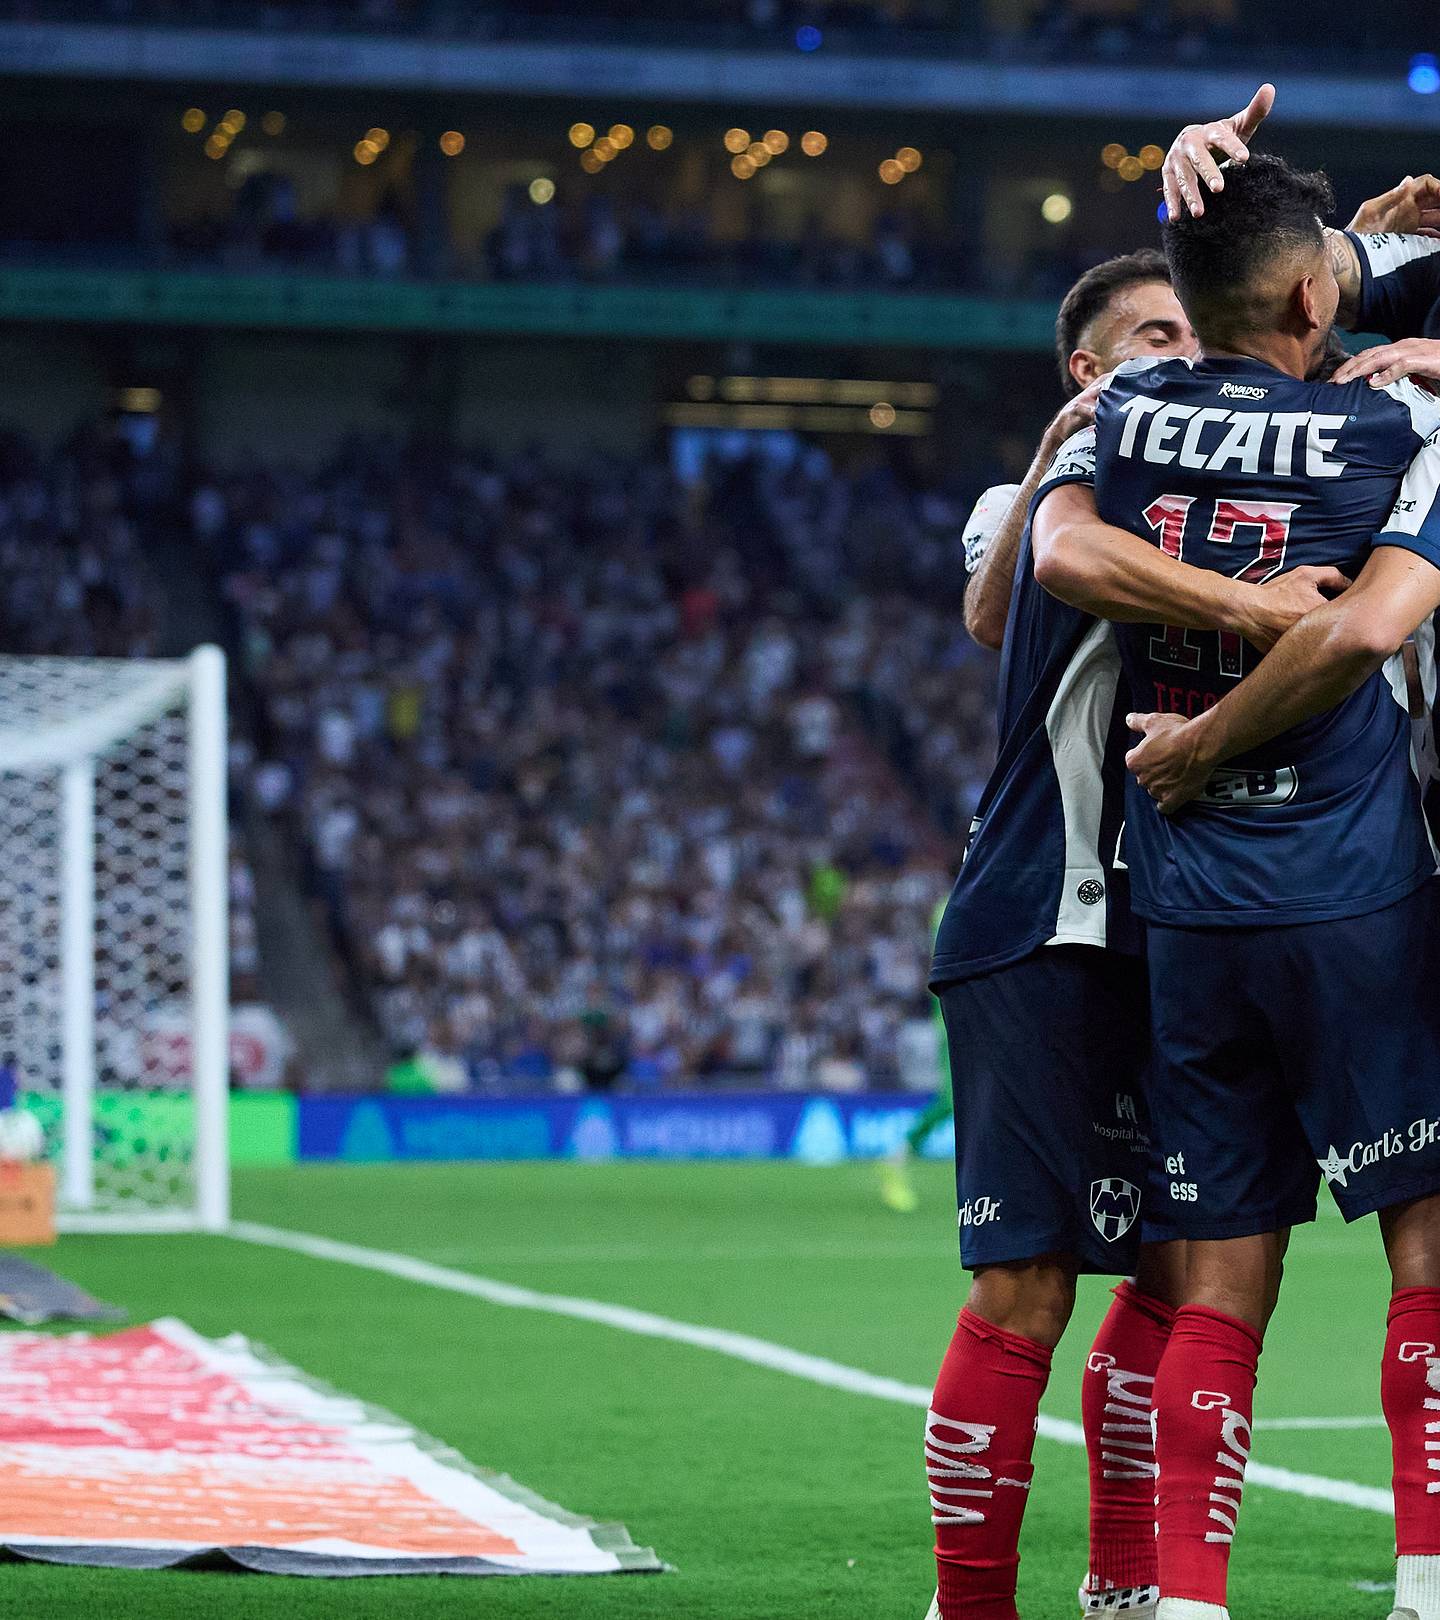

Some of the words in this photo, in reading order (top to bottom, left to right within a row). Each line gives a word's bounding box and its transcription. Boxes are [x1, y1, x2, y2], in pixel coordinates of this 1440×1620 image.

[1218, 382, 1268, 400] RAYADOS
[1119, 394, 1348, 478] TECATE
[1141, 494, 1302, 678] 17
[1349, 1128, 1404, 1173] Carl's
[973, 1196, 1001, 1227] Jr.
